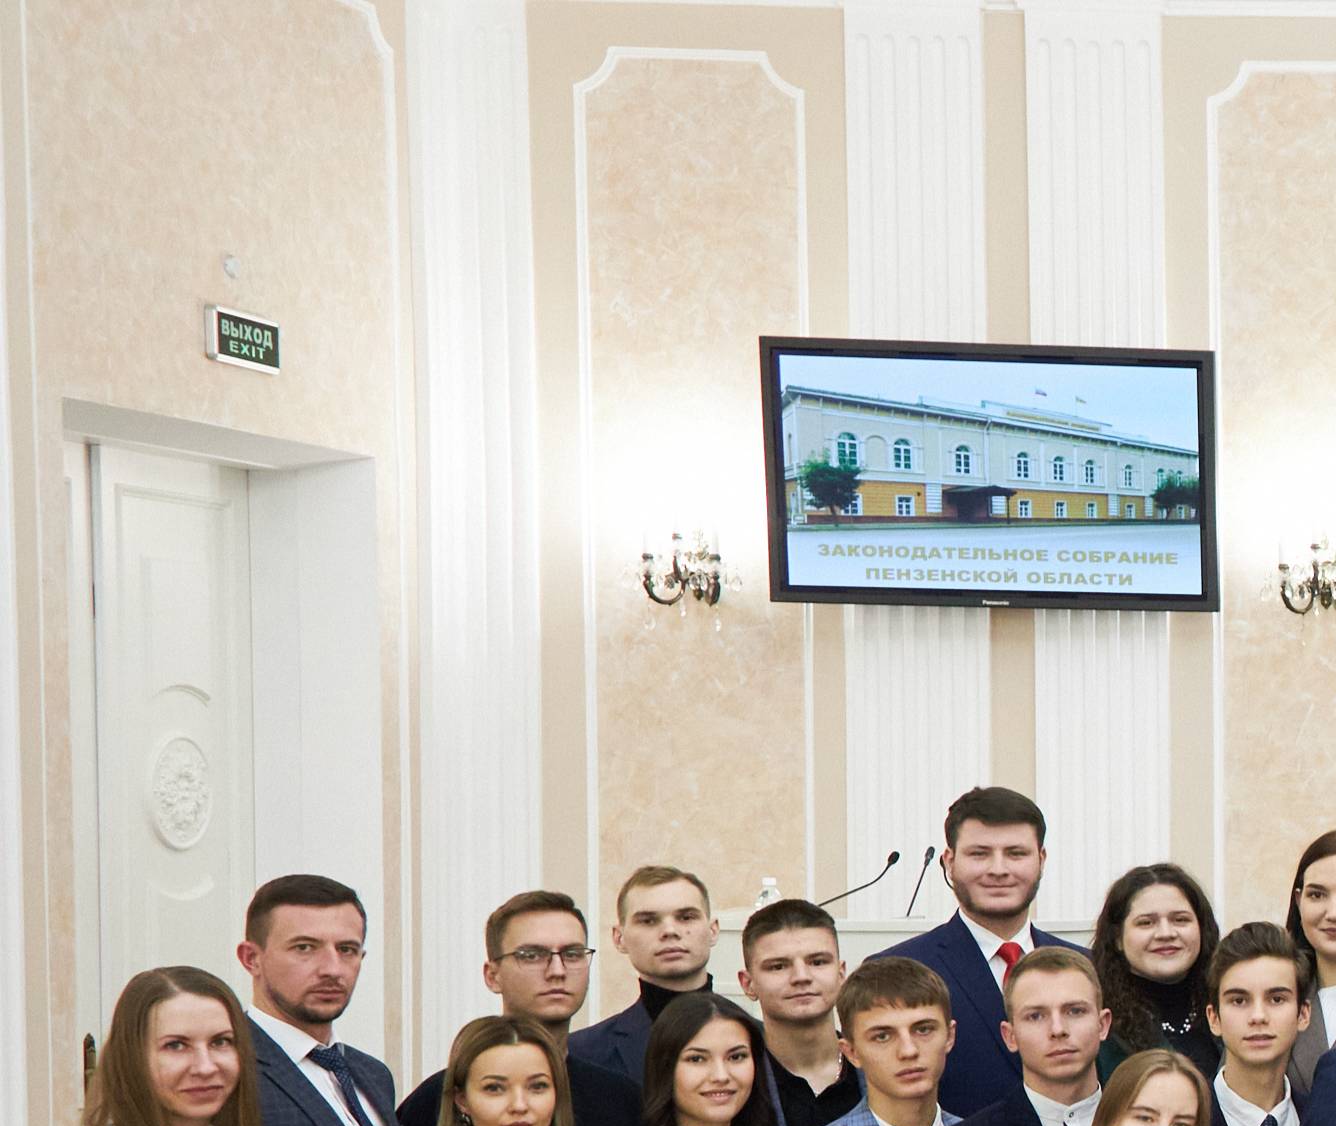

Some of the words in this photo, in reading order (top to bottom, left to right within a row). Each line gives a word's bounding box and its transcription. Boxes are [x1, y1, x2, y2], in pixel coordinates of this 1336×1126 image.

[220, 318, 274, 351] ВЫХОД
[229, 340, 267, 360] EXIT
[817, 543, 1049, 562] ЗАКОНОДАТЕЛЬНОЕ
[1056, 549, 1179, 566] СОБРАНИЕ
[865, 567, 1018, 585] ПЕНЗЕНСКОЙ
[1026, 571, 1133, 587] ОБЛАСТИ
